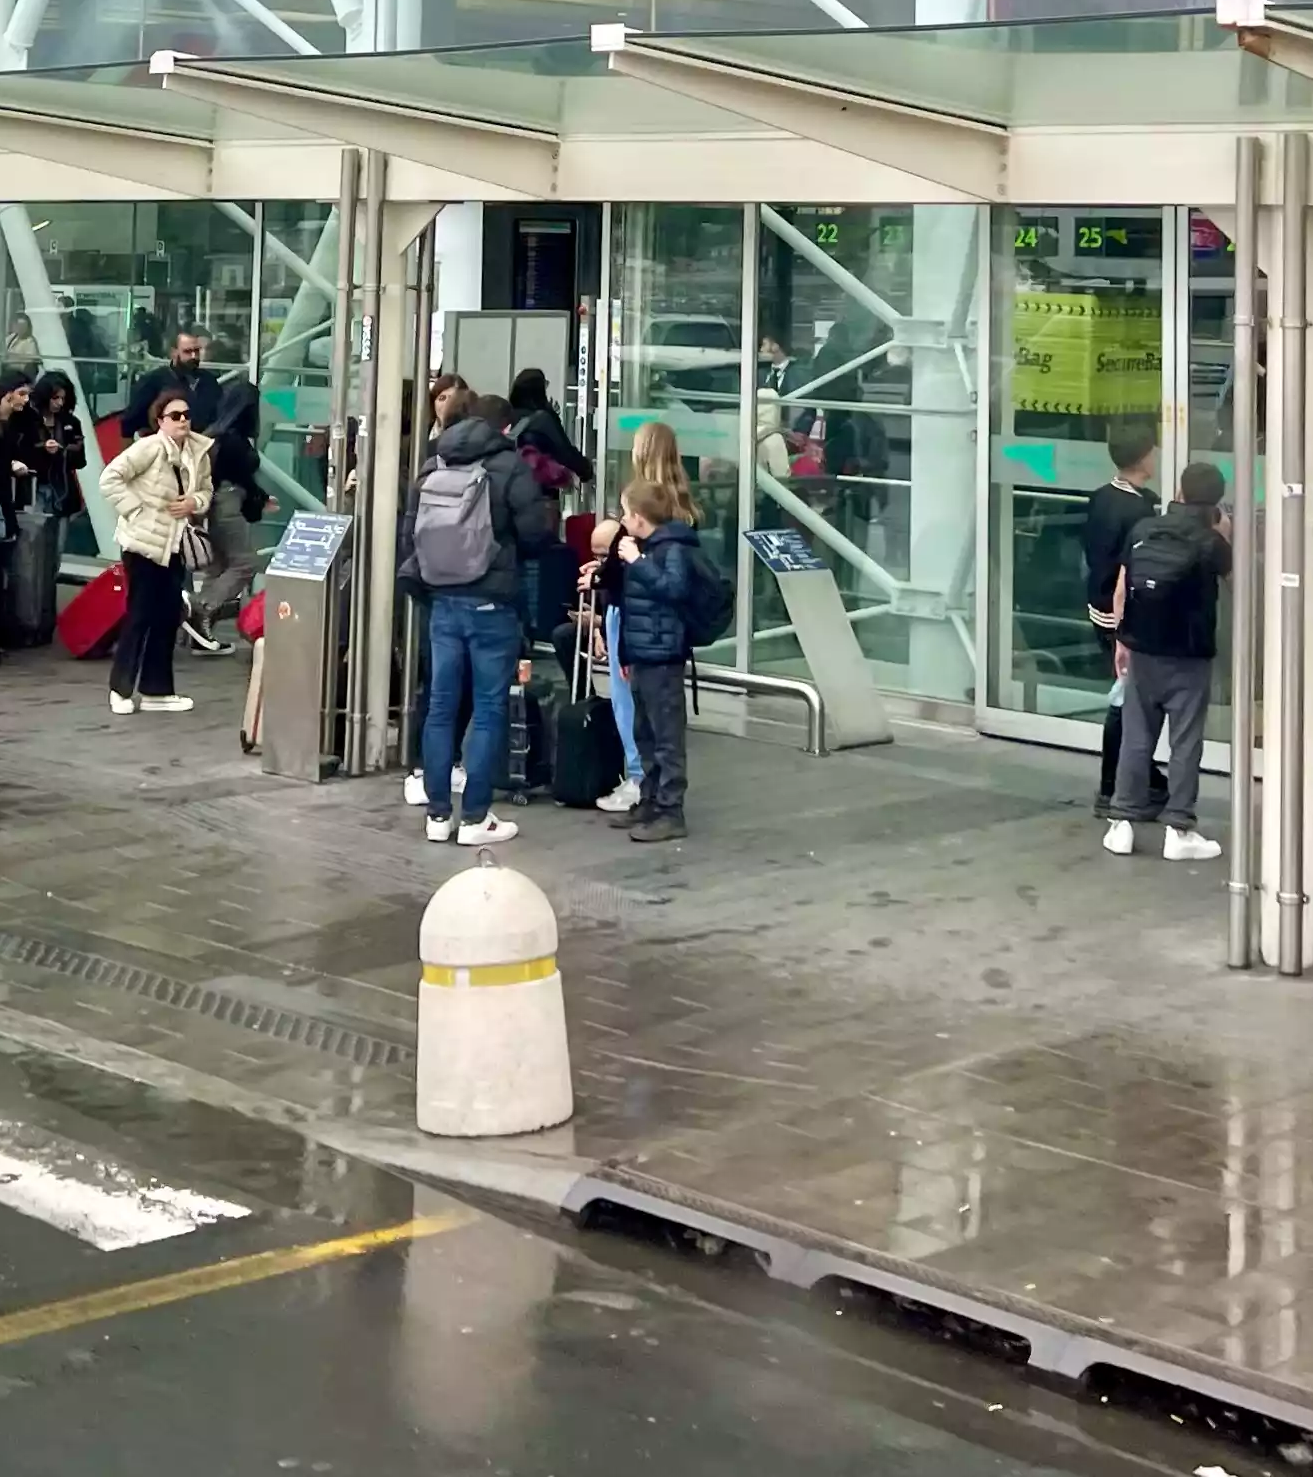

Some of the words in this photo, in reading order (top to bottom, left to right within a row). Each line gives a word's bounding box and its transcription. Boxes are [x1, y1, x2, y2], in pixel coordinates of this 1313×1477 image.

[817, 224, 838, 243] 22
[1015, 227, 1037, 247] 24
[1079, 227, 1102, 248] 25
